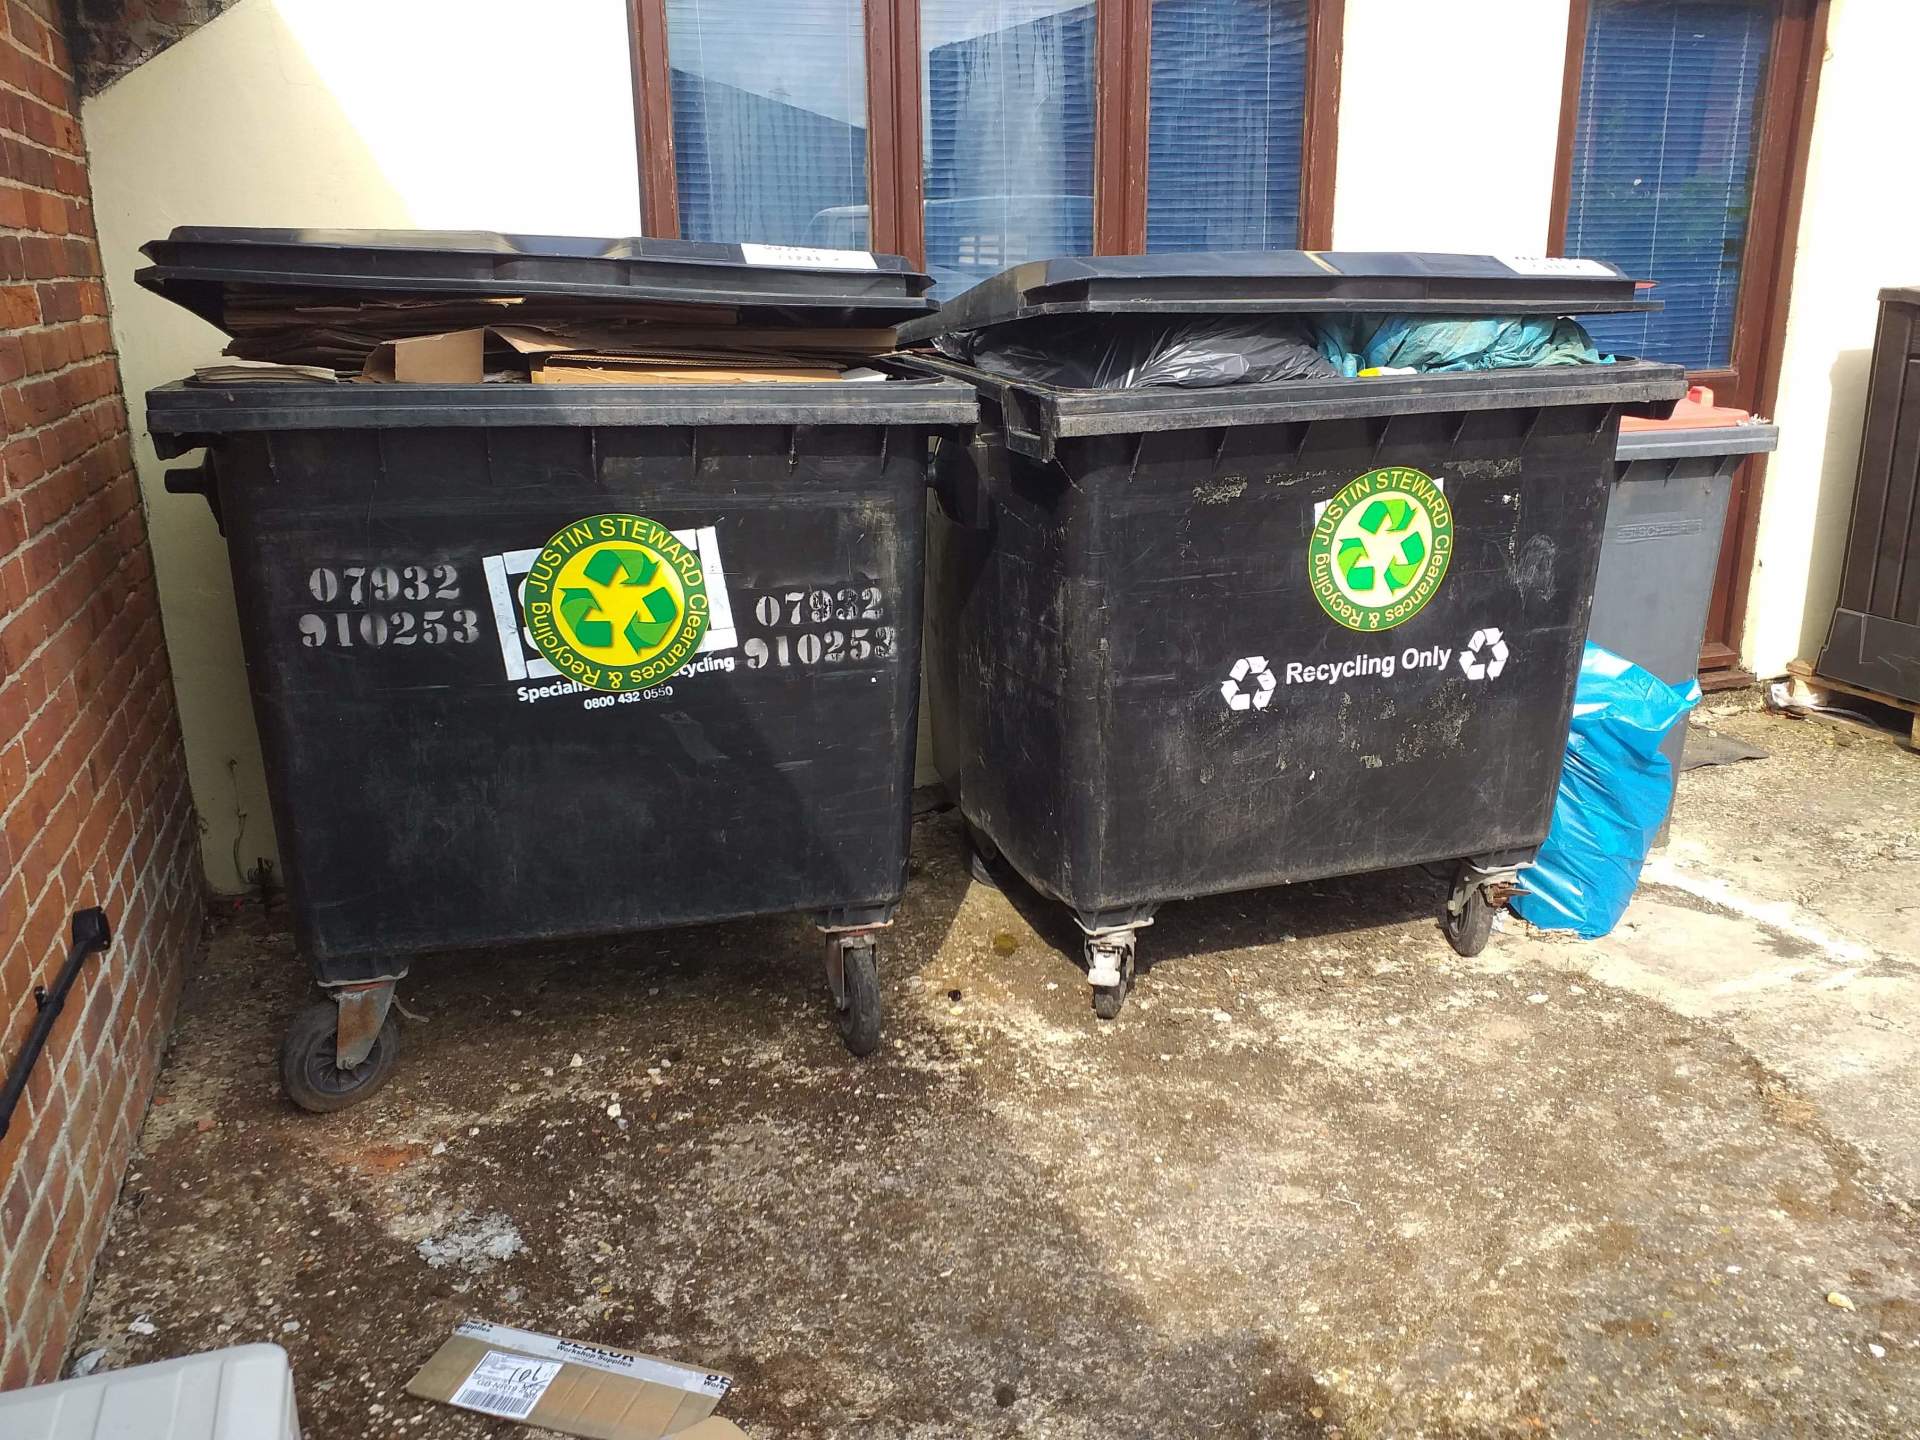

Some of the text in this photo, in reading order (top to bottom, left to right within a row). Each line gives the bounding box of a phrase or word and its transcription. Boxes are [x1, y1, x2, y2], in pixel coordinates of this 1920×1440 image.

[1315, 471, 1449, 546] JUSTIN STEWARD
[530, 518, 703, 593] JUSTIN STEWARD
[309, 564, 460, 605] 07932
[1314, 534, 1450, 628] Clearances & Recycling
[755, 587, 883, 627] 07932
[299, 609, 479, 648] 910253
[531, 593, 708, 689] Clearances & Recycling
[744, 626, 897, 669] 910253
[673, 657, 736, 678] cycling
[1286, 645, 1452, 685] Recycling Only
[584, 685, 673, 710] 0800 432 0550
[557, 1344, 596, 1359] Workshop
[597, 1355, 632, 1368] Supplies
